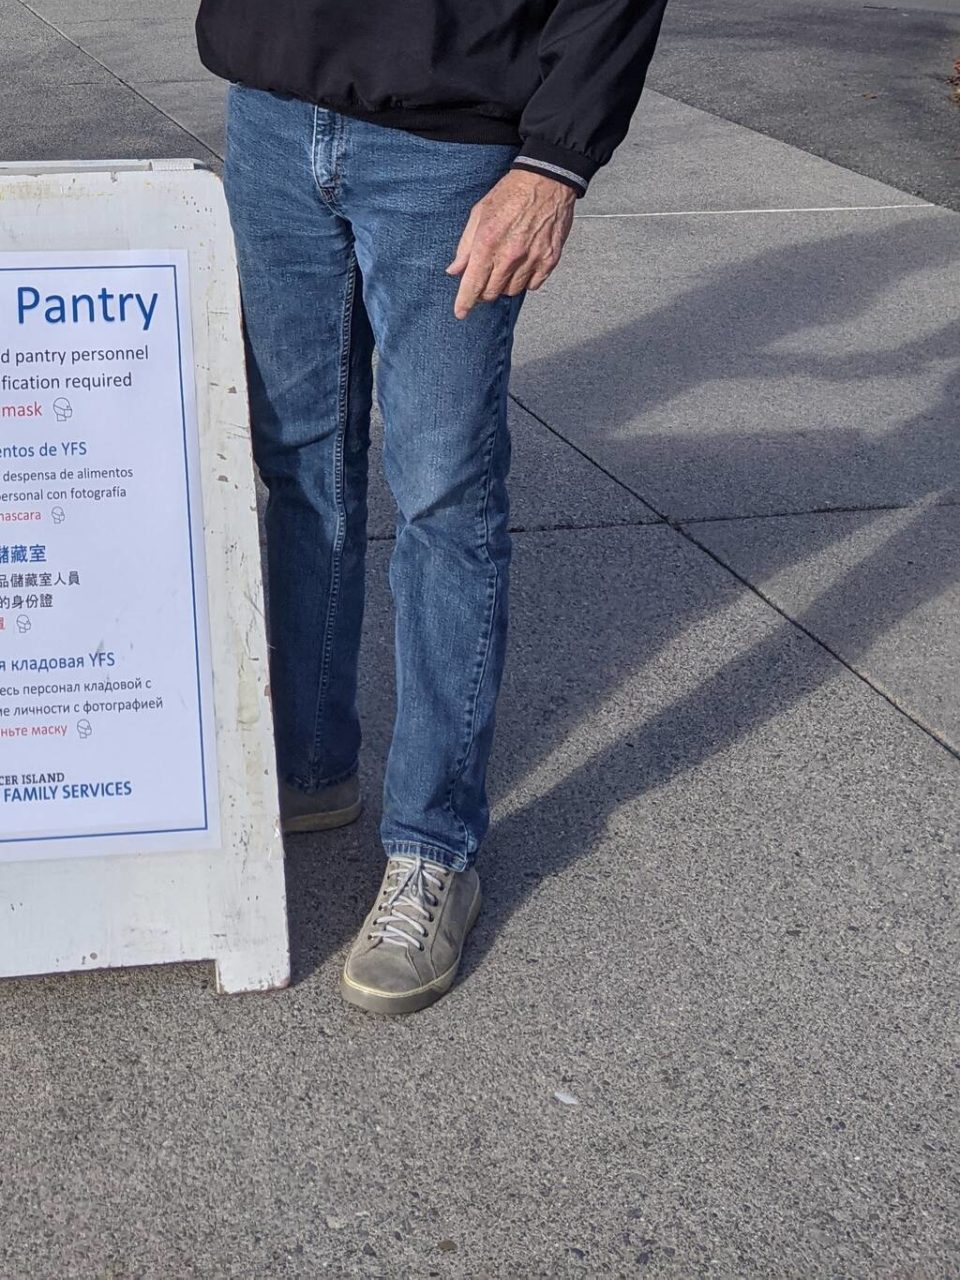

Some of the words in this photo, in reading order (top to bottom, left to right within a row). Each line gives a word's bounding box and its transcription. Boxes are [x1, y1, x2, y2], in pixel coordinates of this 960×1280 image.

[17, 286, 159, 331] Pantry
[15, 349, 67, 367] pantry
[71, 344, 149, 366] personnel
[65, 371, 132, 392] required
[1, 400, 43, 418] mask
[38, 442, 58, 457] de
[61, 441, 87, 456] YFS
[2, 470, 57, 484] despensa
[59, 468, 74, 480] de
[77, 467, 134, 480] alimentos
[46, 490, 68, 500] con
[70, 485, 127, 501] fotografía
[11, 656, 85, 673] кладовая
[88, 650, 116, 668] YFS
[22, 683, 81, 697] персонал
[83, 677, 142, 694] кладовой
[13, 704, 71, 717] личности
[82, 696, 164, 715] фотографией
[31, 724, 68, 737] маску
[21, 772, 65, 785] ISLAND
[3, 785, 59, 803] FAMILY
[61, 780, 133, 800] SERVICES
